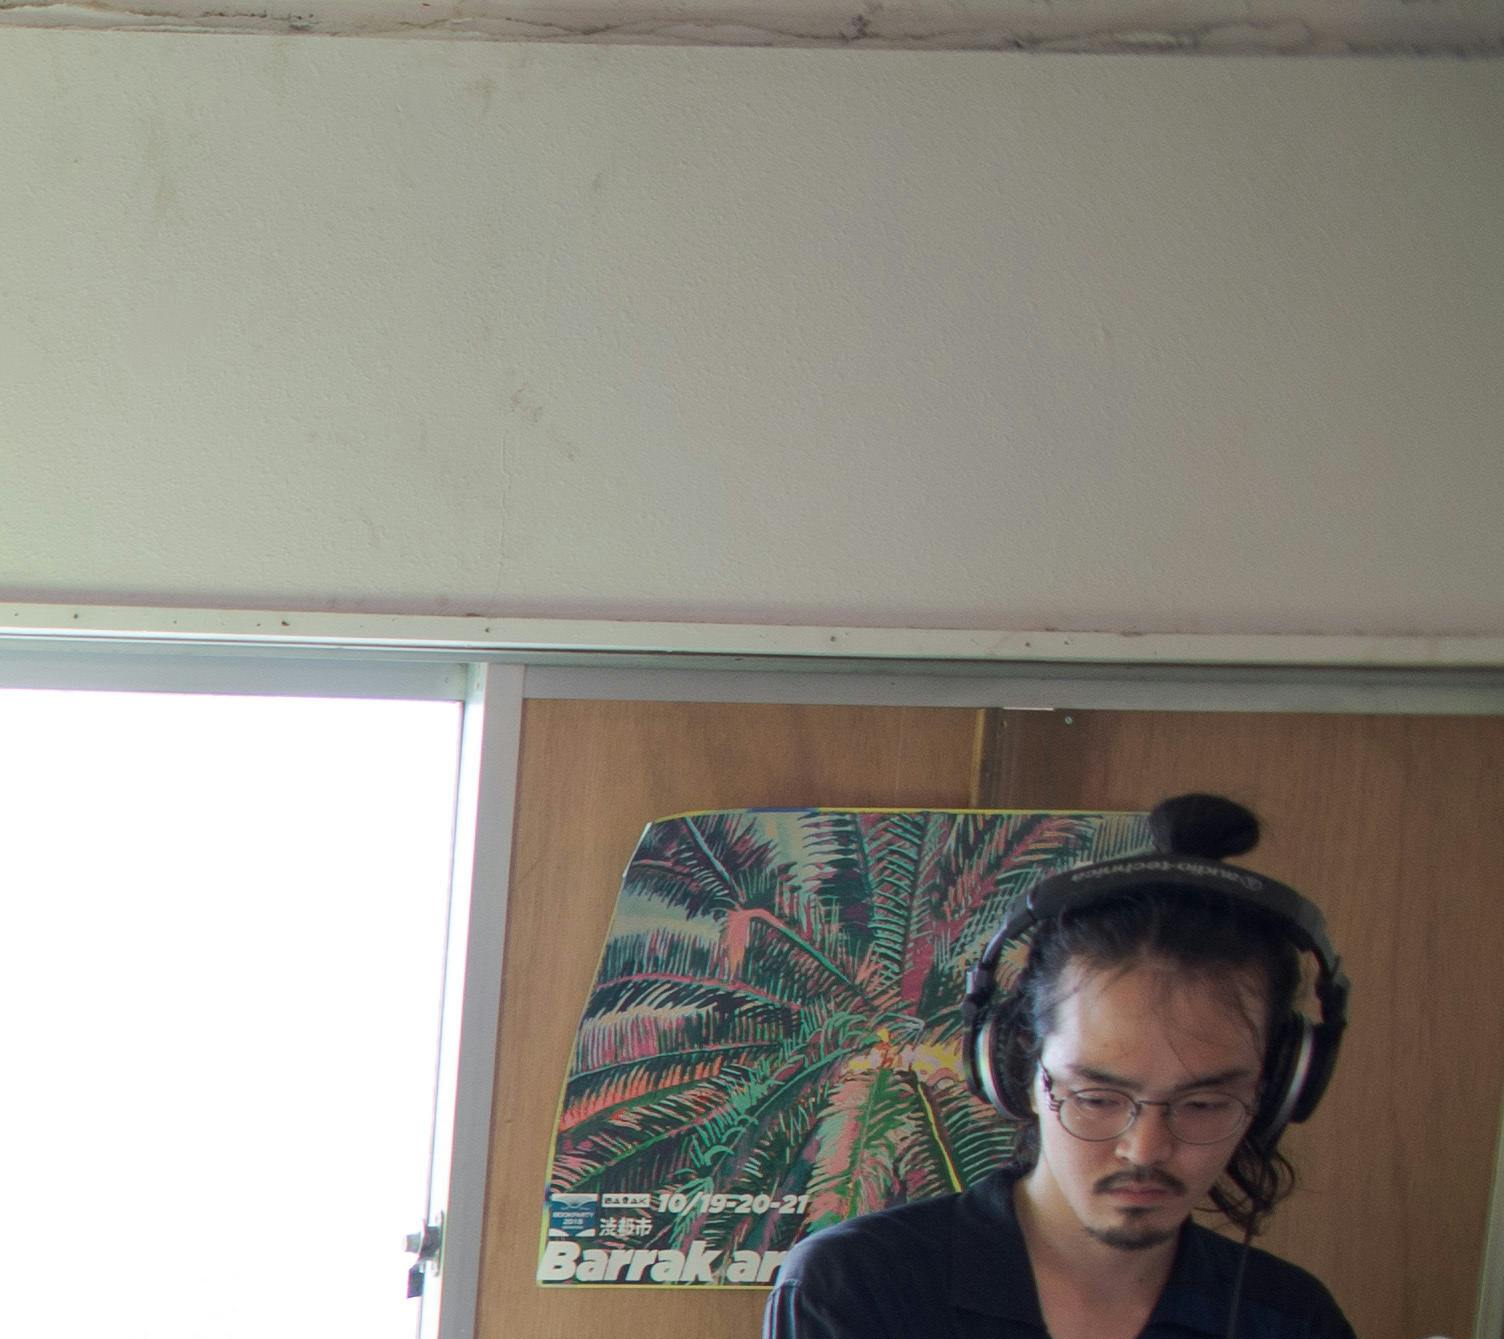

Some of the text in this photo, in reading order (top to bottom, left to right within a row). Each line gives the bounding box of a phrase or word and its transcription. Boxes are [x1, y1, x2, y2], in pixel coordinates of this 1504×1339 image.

[1071, 860, 1240, 882] audio-technica
[657, 1193, 809, 1215] 10/19-20-21
[543, 1240, 787, 1283] Barrak ar
